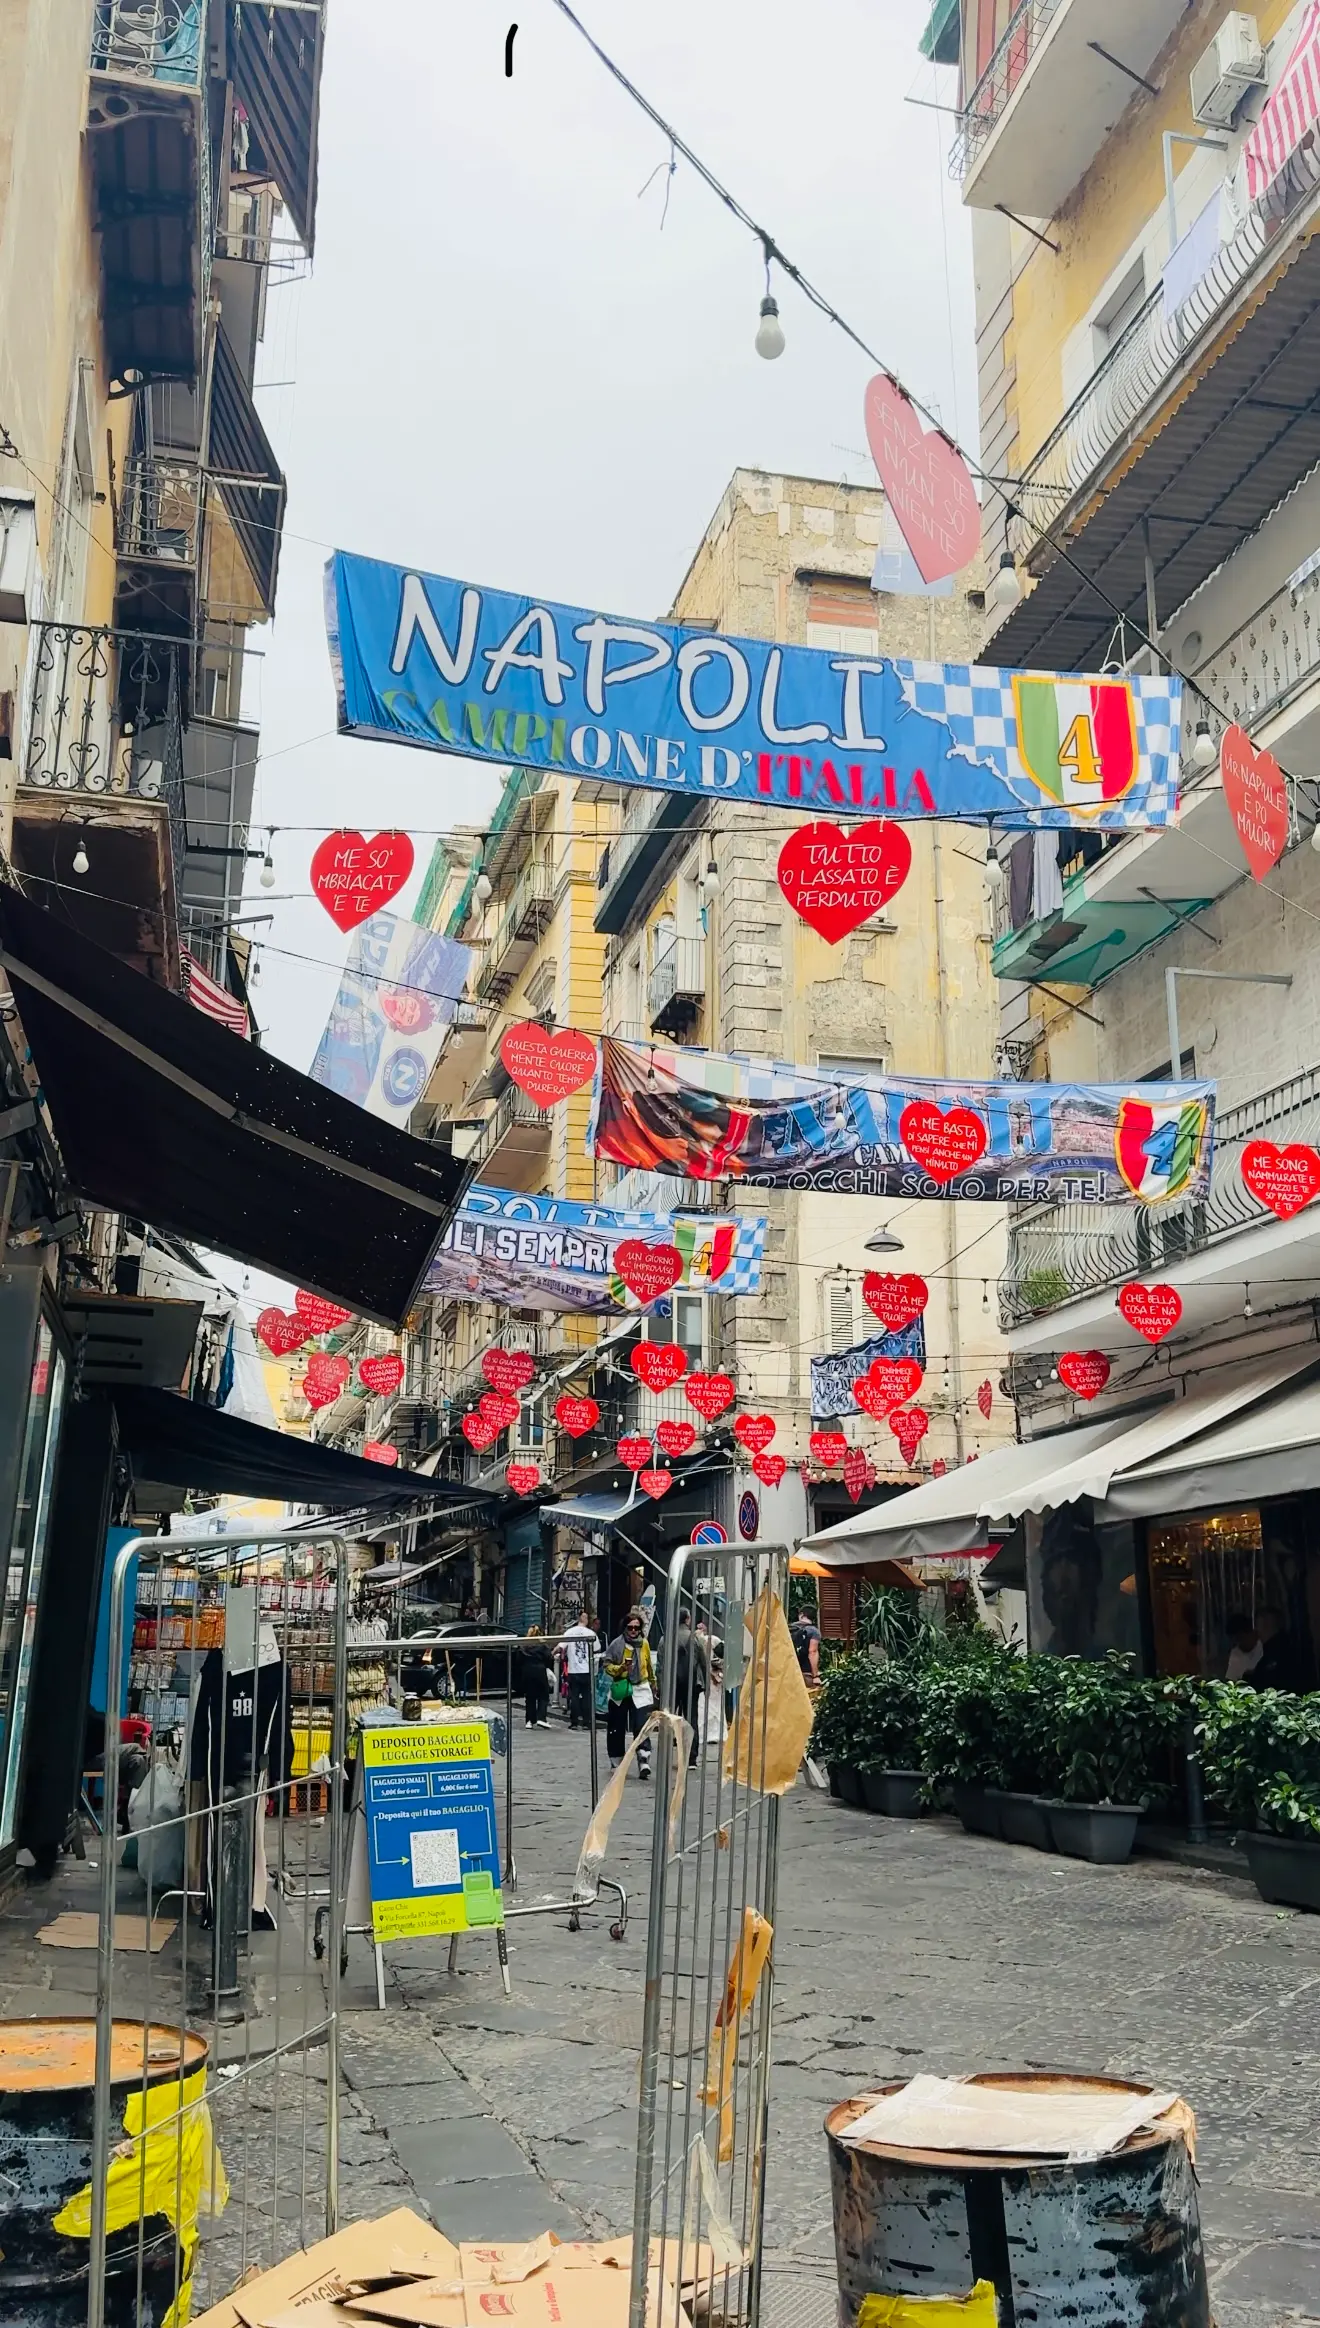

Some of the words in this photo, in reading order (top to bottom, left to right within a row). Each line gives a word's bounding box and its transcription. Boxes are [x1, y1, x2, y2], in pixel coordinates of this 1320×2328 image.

[946, 469, 970, 513] TE
[891, 481, 959, 564] NIENTE
[944, 499, 965, 536] SO
[390, 573, 886, 752] NAPOLI
[1057, 715, 1104, 784] 4
[381, 688, 686, 783] CAMPIONE
[699, 745, 937, 811] D'ITALIA
[334, 848, 364, 868] ME
[803, 844, 882, 865] TUTTO
[801, 868, 878, 886] LASSATO
[352, 896, 371, 912] TE
[797, 890, 882, 908] PERDUTO
[506, 1039, 547, 1054] QUESTA
[550, 1047, 594, 1062] GUERRA
[550, 1060, 584, 1074] CUORE
[512, 1066, 552, 1081] QUANTO
[557, 1073, 583, 1085] TEMPO
[909, 1117, 917, 1127] A
[922, 1118, 940, 1130] ME
[944, 1122, 977, 1138] BASTA
[917, 1133, 950, 1146] SAPERE
[933, 1148, 961, 1159] ANCHE
[1253, 1157, 1272, 1169] ME
[1276, 1158, 1308, 1172] SONG
[788, 1169, 887, 1195] OCCHI
[900, 1173, 985, 1199] SOLO
[996, 1177, 1050, 1201] PER
[1062, 1170, 1109, 1203] TE!
[1267, 1183, 1291, 1191] PAZZO
[1310, 1176, 1315, 1184] E
[1278, 1193, 1303, 1201] PAZZO
[1275, 1202, 1281, 1210] E
[626, 1252, 642, 1260] UN
[645, 1254, 674, 1265] GIORNO
[644, 1283, 657, 1295] TE
[900, 1295, 908, 1304] A
[911, 1297, 924, 1306] ME
[1126, 1294, 1144, 1303] CHE
[1148, 1295, 1176, 1304] BELLA
[1125, 1305, 1147, 1314] COSA
[1162, 1307, 1176, 1315] NA
[261, 1325, 273, 1334] ME
[276, 1327, 305, 1341] PARLA
[280, 1339, 290, 1348] TE
[643, 1352, 662, 1364] TU
[887, 1392, 906, 1400] CORE
[232, 1698, 252, 1717] 98
[372, 1737, 425, 1748] DEPOSITO
[428, 1733, 480, 1745] BAGAGLIO
[382, 1750, 428, 1761] LUGGAGE
[430, 1747, 473, 1758] STORAGE
[374, 1778, 405, 1786] BAGAGLIO
[378, 1810, 409, 1821] Deposita
[411, 1810, 422, 1819] qui
[442, 1805, 483, 1814] BAGAGLIO
